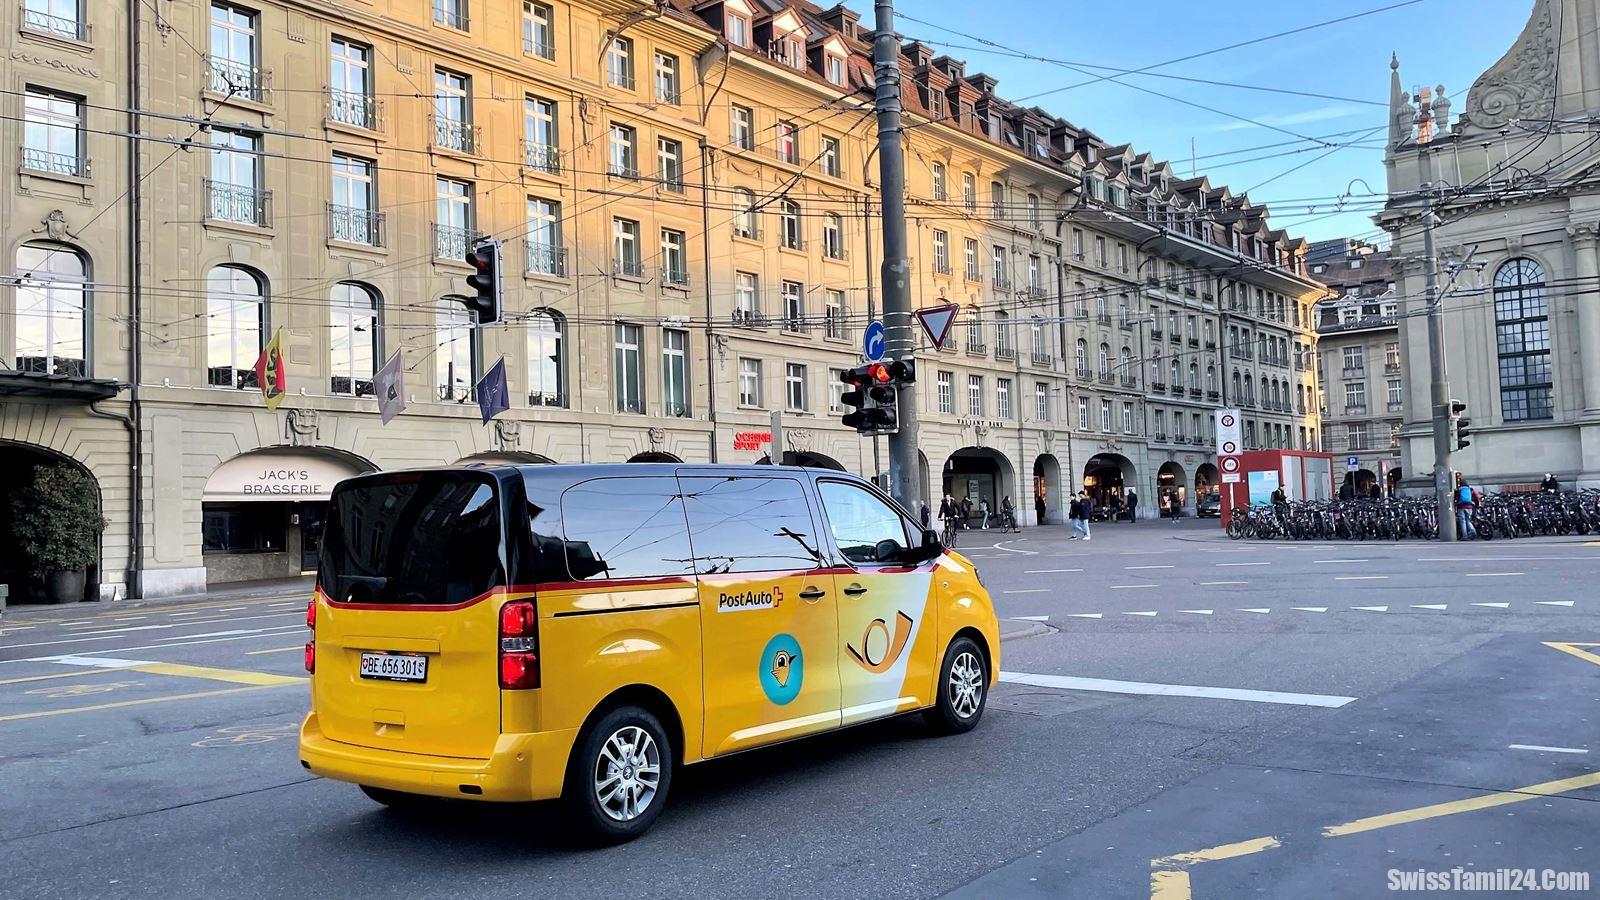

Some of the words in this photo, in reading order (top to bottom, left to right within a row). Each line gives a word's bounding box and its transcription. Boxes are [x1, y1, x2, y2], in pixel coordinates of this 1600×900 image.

[736, 432, 773, 442] OCHSNE
[733, 441, 760, 450] SPORT
[258, 470, 308, 480] JACK'S
[243, 484, 321, 495] BRASSERIE
[719, 591, 772, 608] PostAuto
